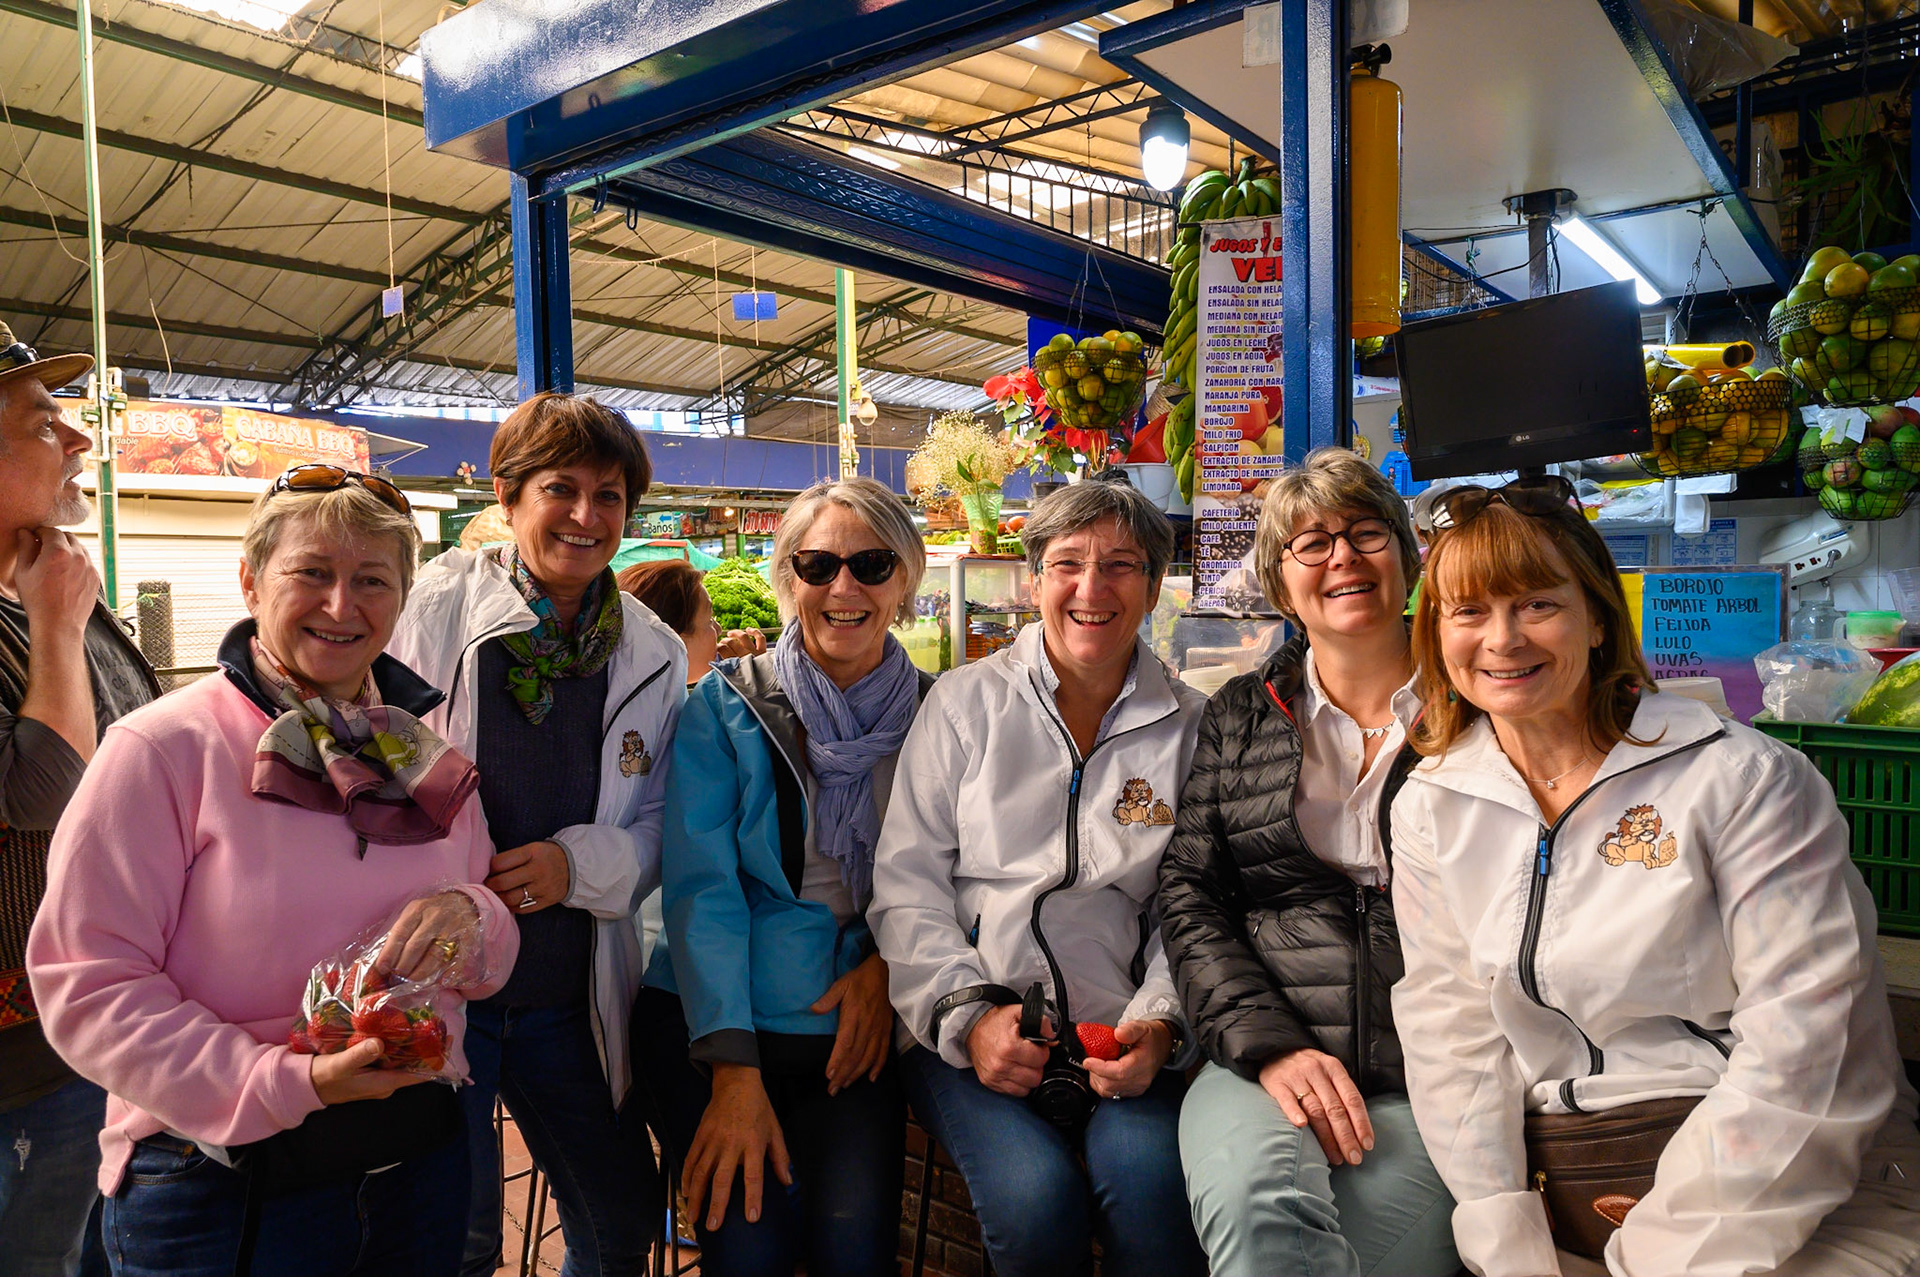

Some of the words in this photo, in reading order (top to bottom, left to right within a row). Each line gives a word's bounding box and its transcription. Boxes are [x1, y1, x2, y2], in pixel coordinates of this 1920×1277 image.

[1210, 238, 1257, 253] JUGOS
[1261, 237, 1270, 252] Y
[1208, 285, 1245, 295] ENSALADA
[1247, 285, 1262, 294] CON
[1264, 285, 1282, 294] HELA
[1207, 299, 1245, 308] ENSALADA
[1246, 298, 1259, 307] SIN
[1261, 298, 1283, 307] HELAD
[1207, 312, 1241, 321] MEDIANA
[1243, 312, 1258, 320] CON
[1260, 311, 1283, 320] HELAD
[1207, 325, 1241, 334] MEDIANA
[1243, 325, 1256, 334] SIN
[1206, 339, 1231, 348] JUGOS
[1233, 339, 1242, 347] EN
[1244, 338, 1267, 347] LECHE
[1205, 352, 1230, 361] JUGOS
[1232, 352, 1242, 360] EN
[1244, 352, 1264, 360] AGUA
[1205, 365, 1238, 374] PORCION
[1240, 365, 1249, 373] DE
[1251, 365, 1274, 373] FRUTA
[1205, 378, 1246, 387] ZANAHORIA
[1248, 378, 1263, 386] CON
[1265, 378, 1283, 386] NARA
[1205, 391, 1239, 400] NARANJA
[1241, 391, 1261, 399] PURA
[1204, 404, 1249, 413] MANDARINA
[1204, 417, 1234, 426] BOROJO
[128, 411, 197, 442] BBQ
[235, 416, 314, 450] CABAÑA
[316, 429, 356, 459] BBQ
[1204, 430, 1223, 439] MILO
[1224, 430, 1242, 439] FRIO
[114, 437, 138, 446] dable
[1203, 444, 1239, 452] SALPICON
[1203, 456, 1239, 465] EXTRACTO
[1241, 456, 1250, 465] DE
[1203, 469, 1239, 478] EXTRACTO
[1241, 469, 1250, 478] DE
[1202, 483, 1242, 491] LIMONADA
[648, 522, 673, 534] Baños
[1201, 521, 1221, 530] MILO
[1222, 521, 1256, 530] CALIENTE
[1200, 561, 1242, 569] AROMATICA
[1200, 574, 1220, 582] TINTO
[1200, 586, 1225, 595] PERICO
[1659, 577, 1724, 596] BOROJO
[1199, 599, 1226, 607] AREPAS
[1651, 598, 1707, 614] TOMATE
[1716, 597, 1762, 614] ARBOL
[1654, 617, 1711, 632] FEIJOA
[1655, 636, 1691, 651] LULO
[1654, 651, 1703, 667] UVAS
